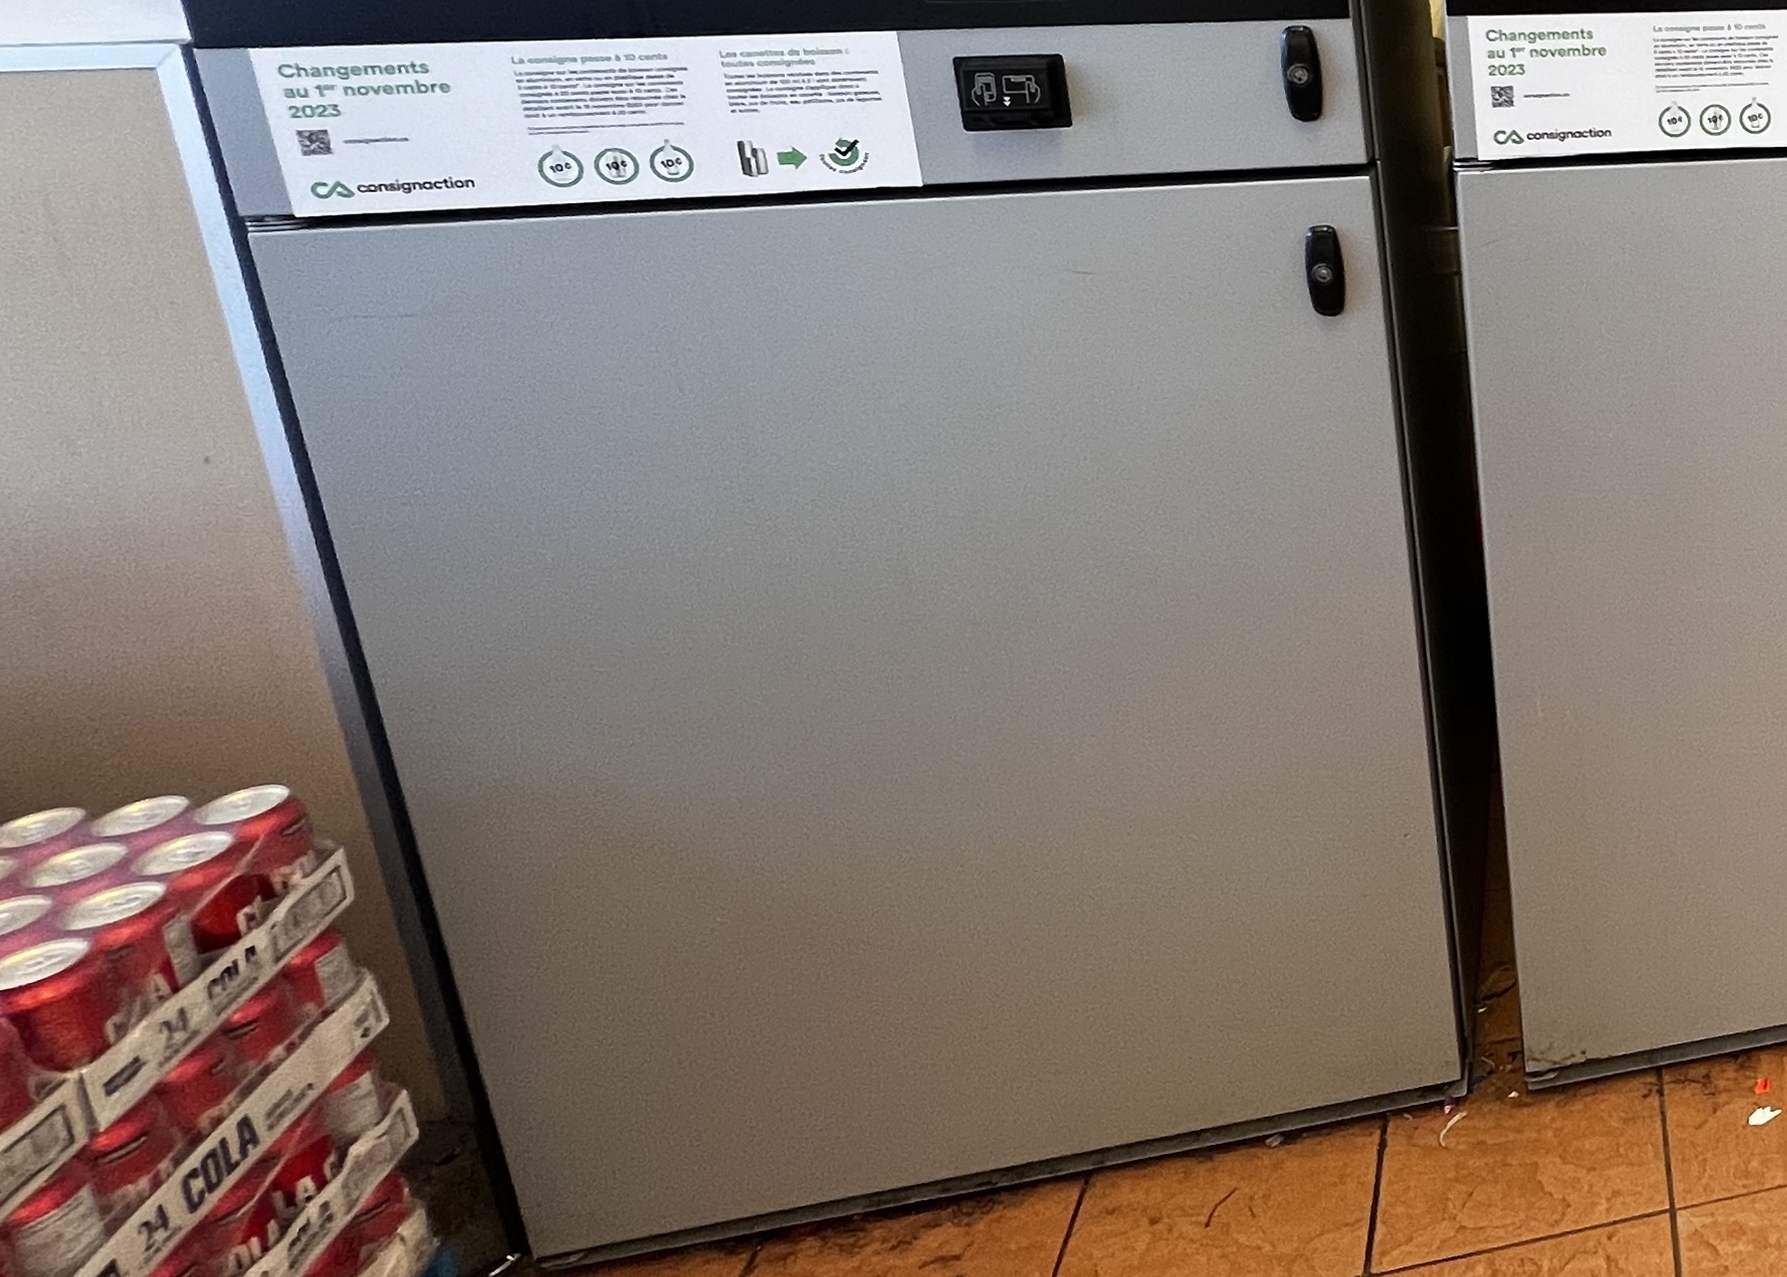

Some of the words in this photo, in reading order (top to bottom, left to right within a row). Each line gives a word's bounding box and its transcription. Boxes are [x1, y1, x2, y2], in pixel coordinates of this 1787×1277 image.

[1485, 28, 1594, 44] Changements
[1487, 49, 1506, 59] au
[1530, 44, 1607, 58] novembre
[277, 61, 430, 80] Changements
[1487, 64, 1526, 76] 2023
[283, 87, 309, 99] au
[342, 80, 452, 97] novembre
[287, 104, 342, 119] 2023
[1526, 127, 1612, 142] consignaction
[356, 176, 476, 194] consignaction
[181, 1113, 261, 1215] COLA
